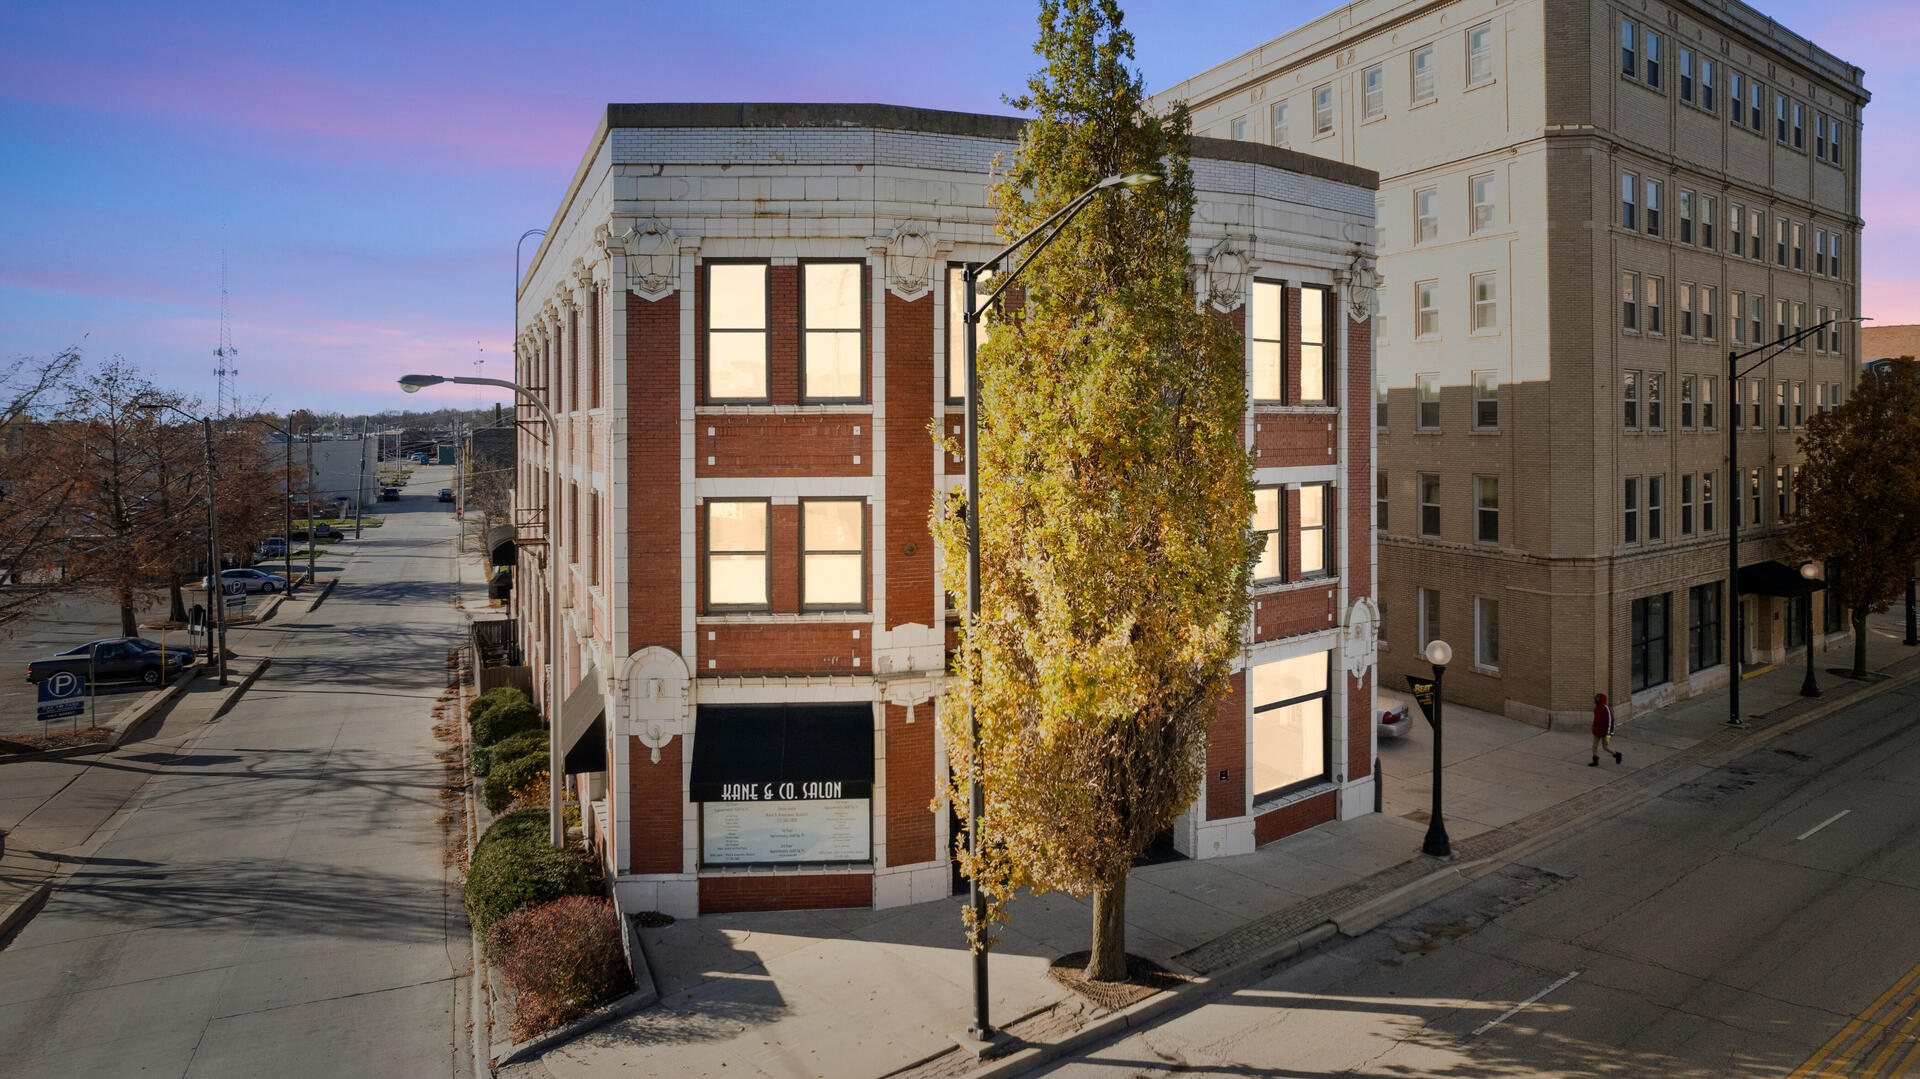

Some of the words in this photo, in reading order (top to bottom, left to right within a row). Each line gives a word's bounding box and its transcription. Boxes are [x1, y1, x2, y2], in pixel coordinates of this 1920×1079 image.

[55, 675, 73, 694] P
[721, 783, 759, 801] KANE
[763, 783, 774, 800] &
[779, 782, 798, 800] CO.
[802, 781, 842, 799] SALON
